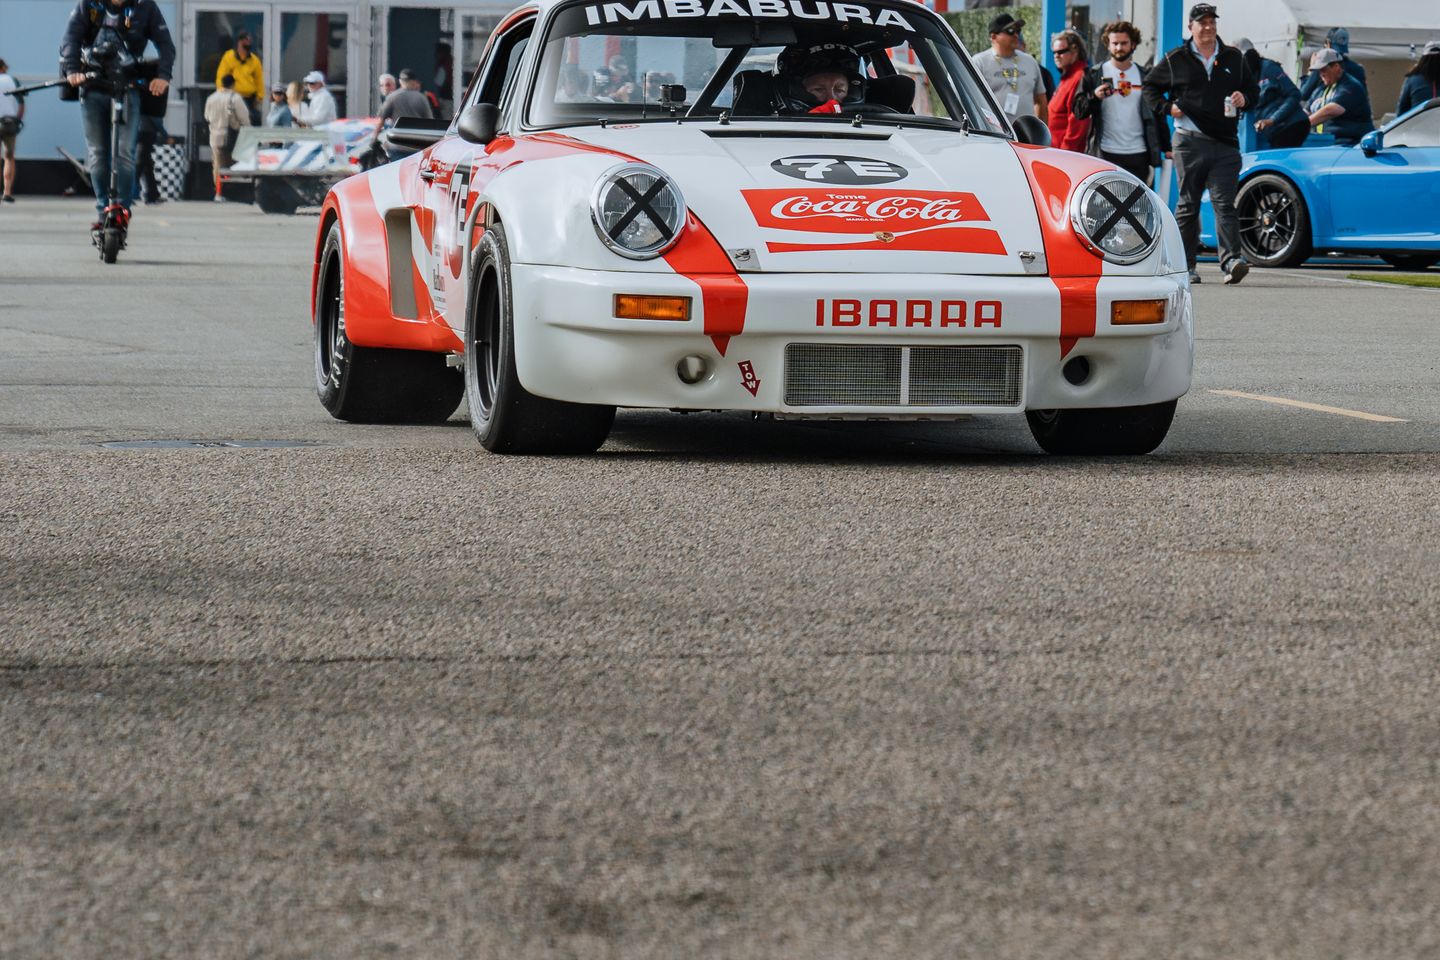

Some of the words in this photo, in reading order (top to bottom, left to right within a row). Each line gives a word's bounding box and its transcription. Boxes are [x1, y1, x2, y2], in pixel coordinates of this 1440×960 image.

[780, 158, 900, 179] 7E
[770, 196, 962, 221] Coca-Cola
[826, 193, 867, 201] Tome
[816, 298, 1003, 328] IBARRA
[742, 363, 756, 389] TOW
